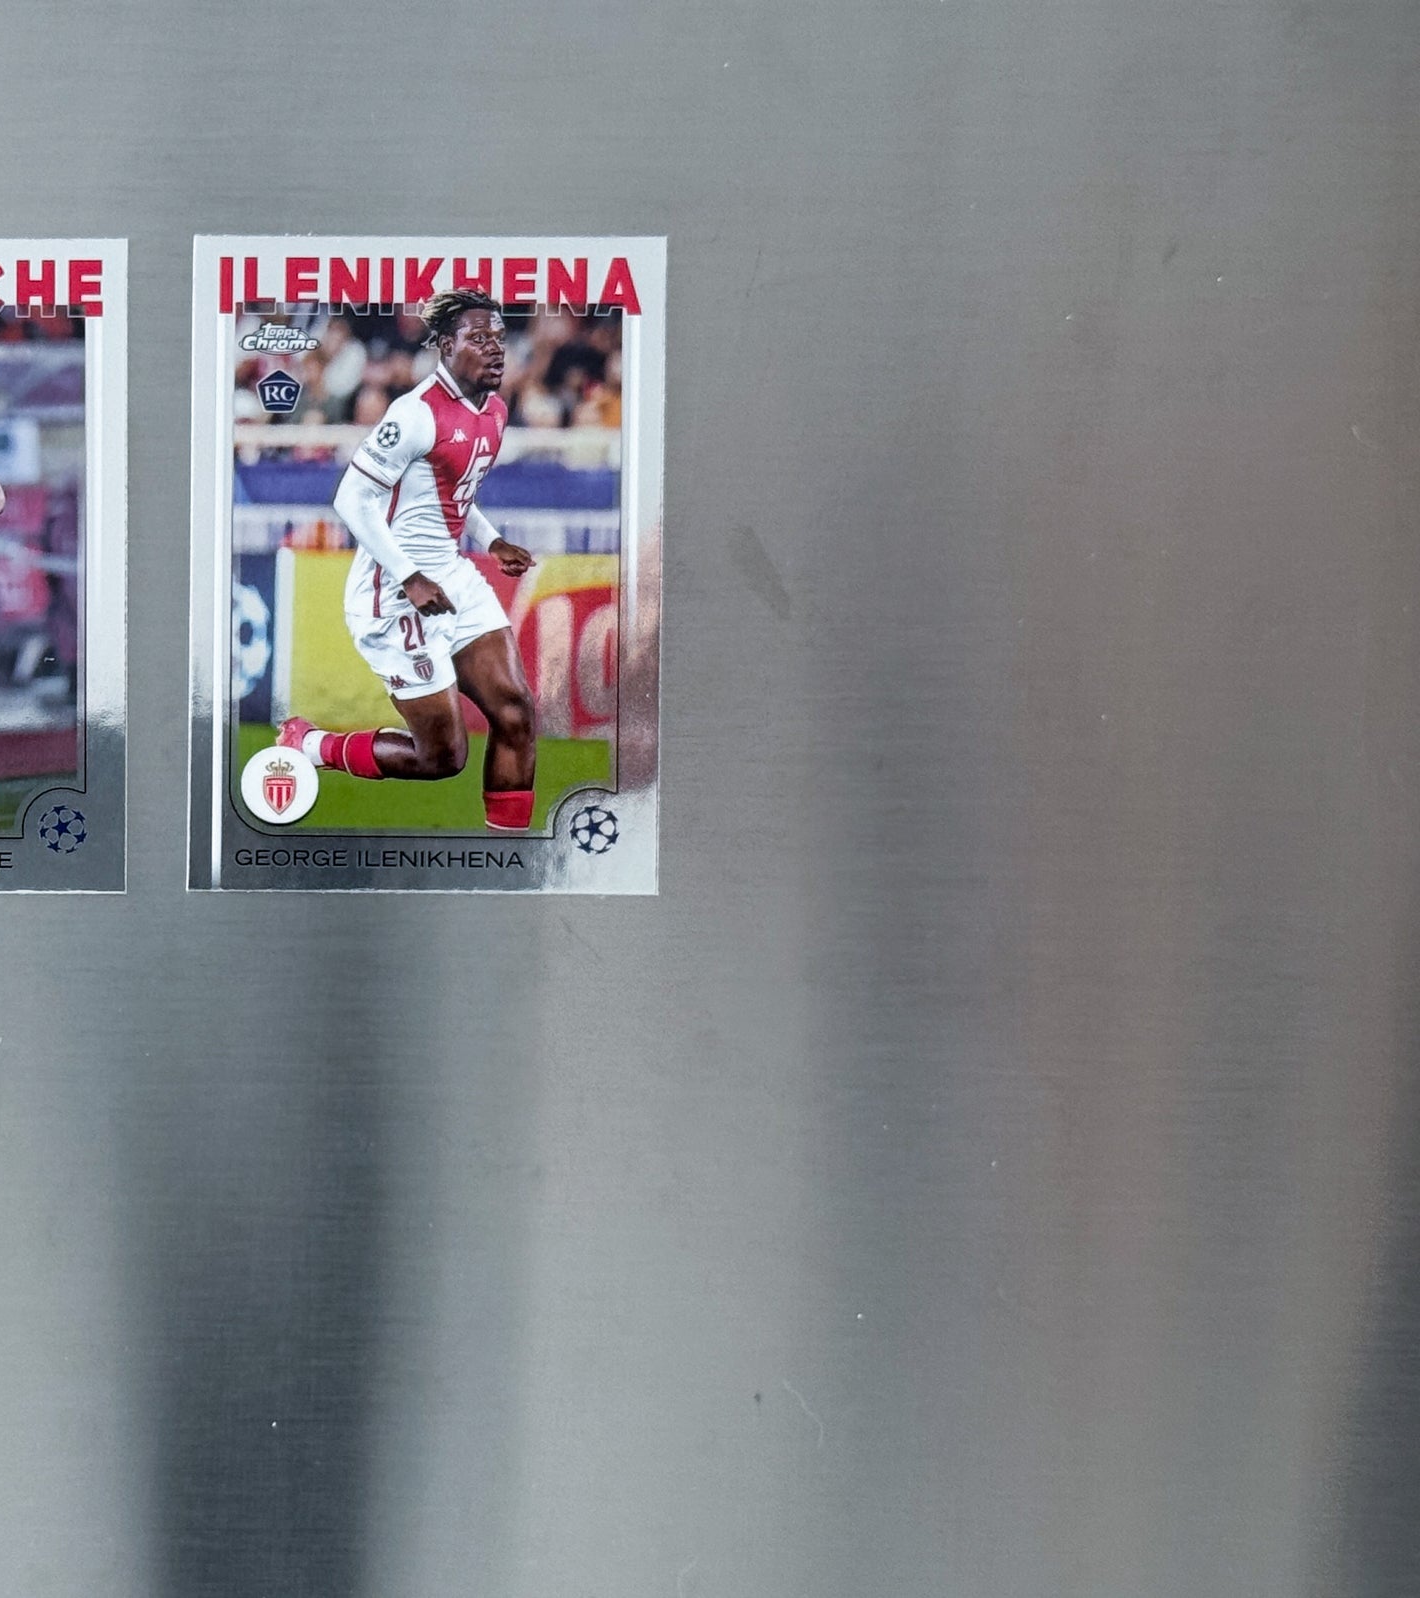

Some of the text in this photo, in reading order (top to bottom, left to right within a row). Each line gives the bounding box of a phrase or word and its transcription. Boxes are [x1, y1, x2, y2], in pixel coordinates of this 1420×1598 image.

[218, 256, 642, 316] ILENIKHENA
[242, 336, 318, 350] Chrome
[264, 385, 297, 402] RC
[398, 611, 427, 652] 21
[234, 848, 525, 869] GEORGE ILENIKHENA
